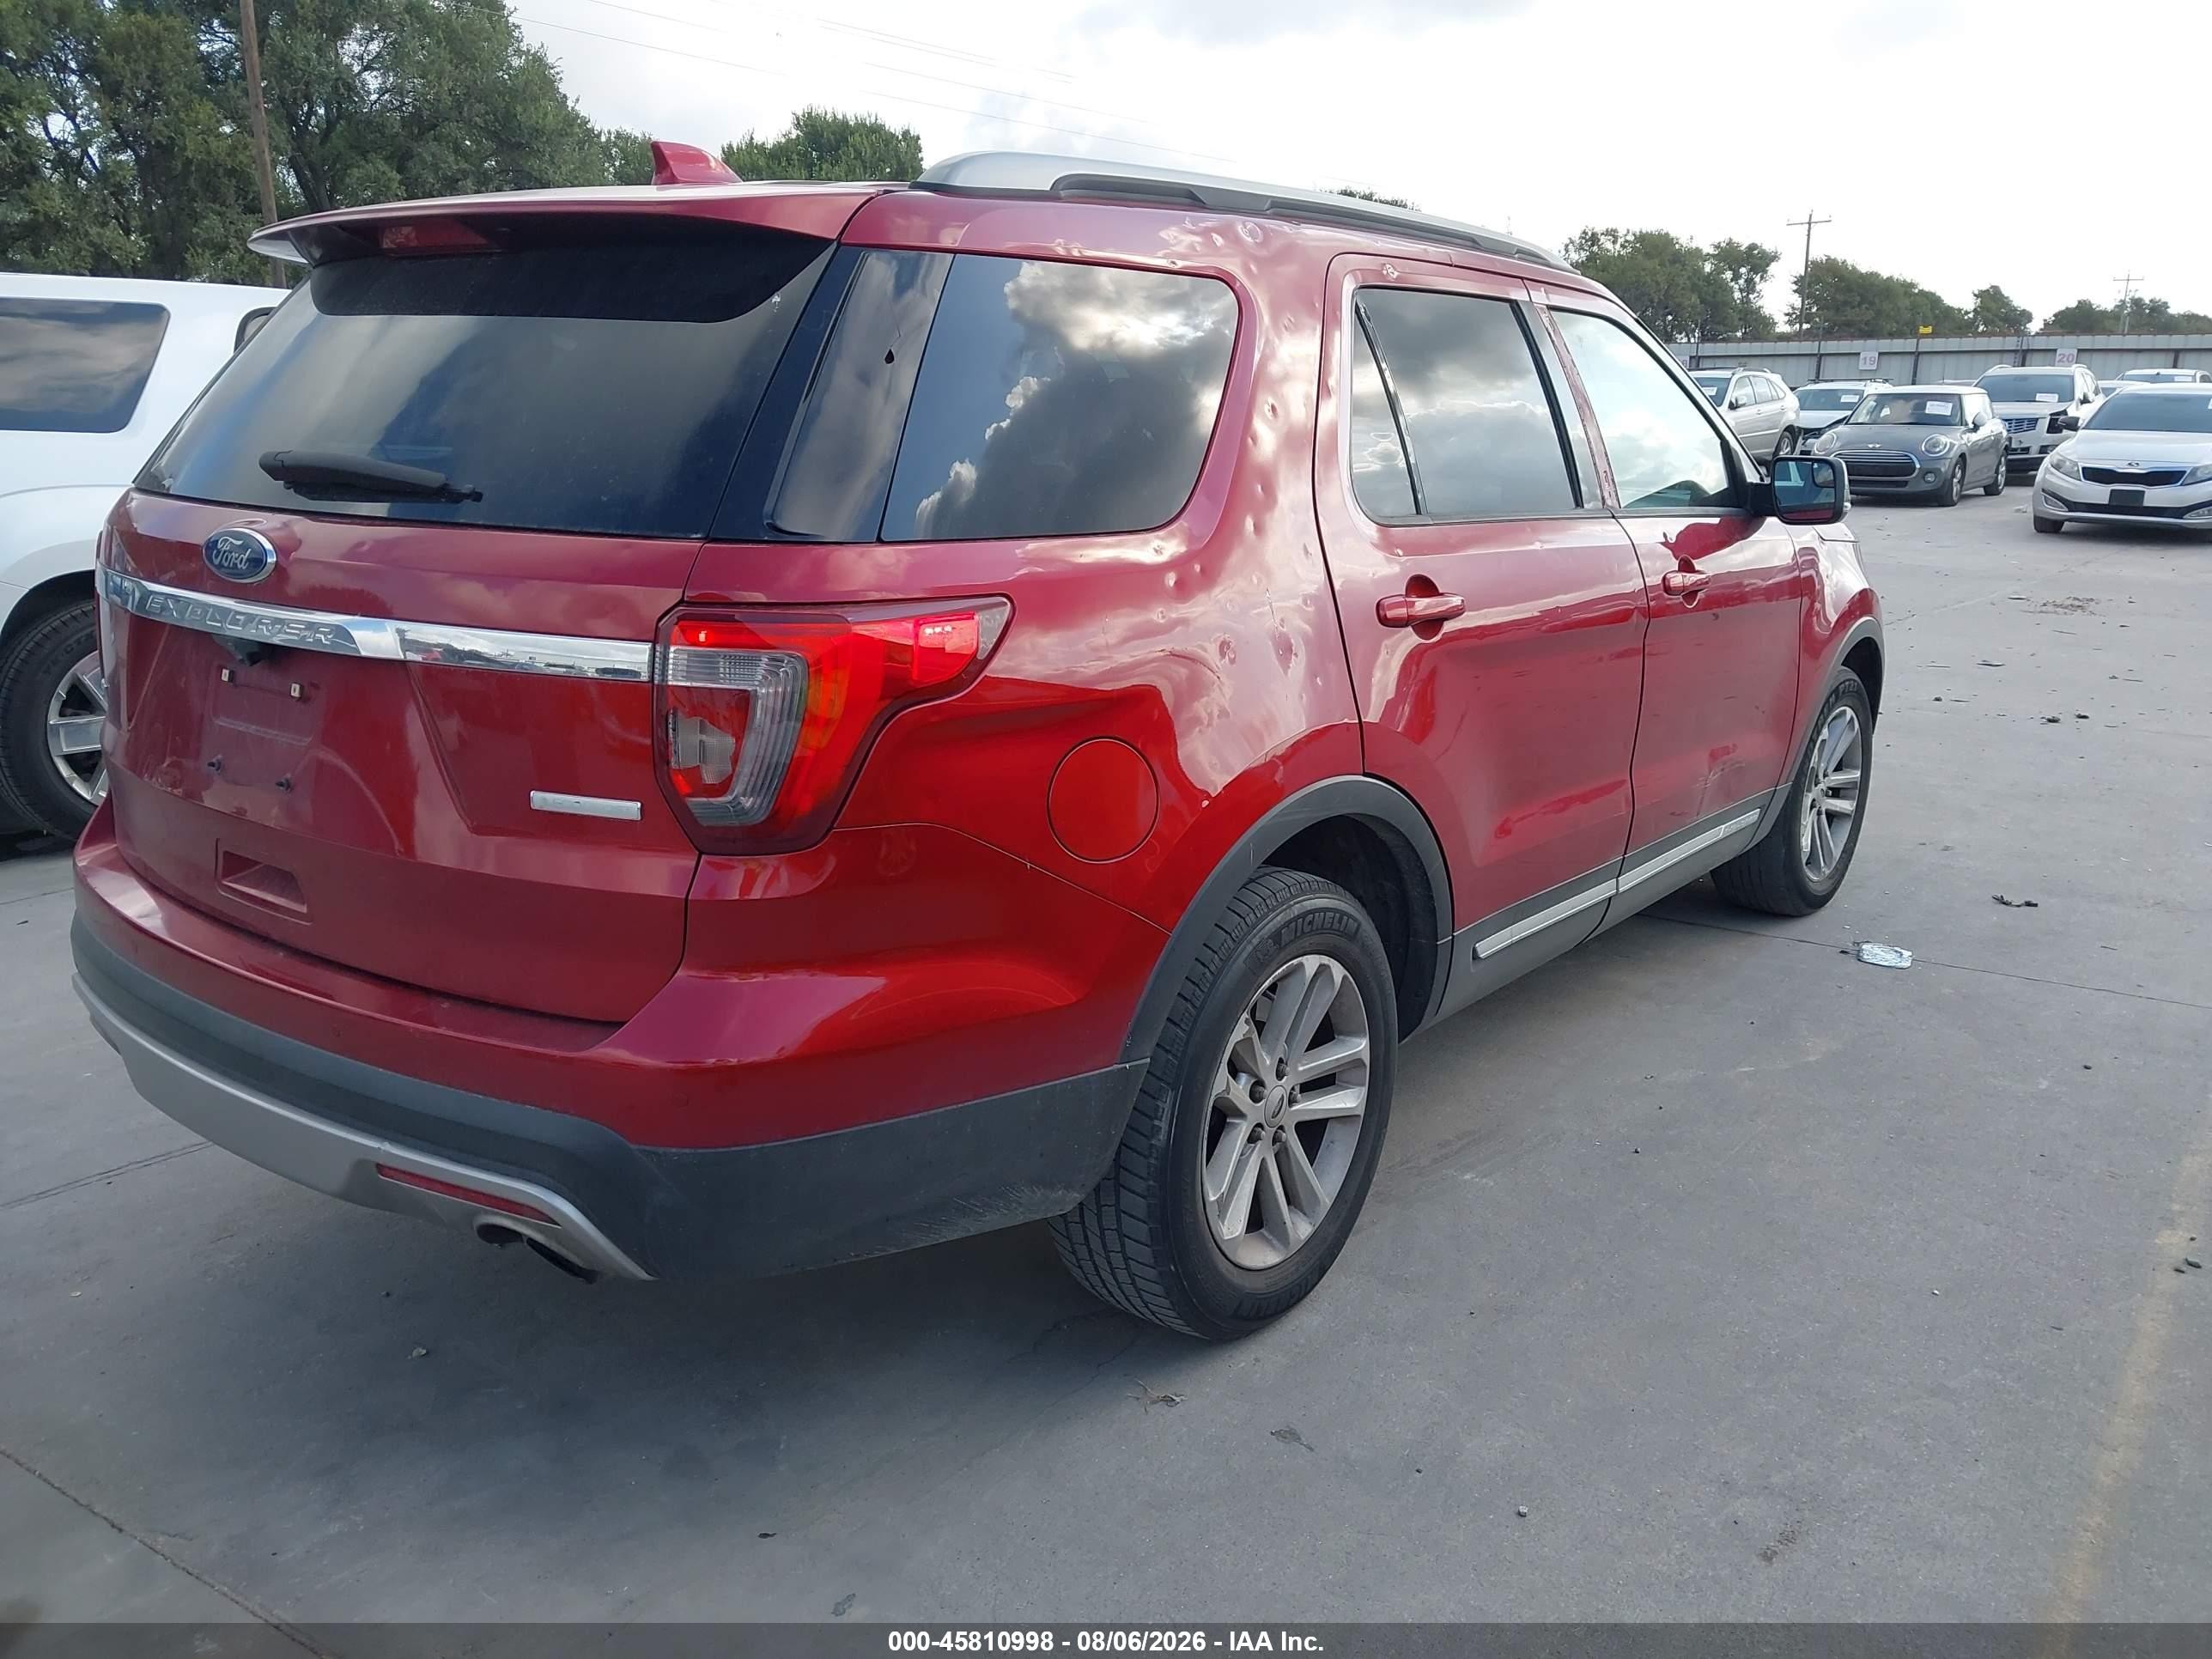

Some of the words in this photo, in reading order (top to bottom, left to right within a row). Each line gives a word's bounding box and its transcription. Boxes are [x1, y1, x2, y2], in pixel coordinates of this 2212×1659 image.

[1861, 356, 1876, 366] 19
[2057, 353, 2075, 364] 20
[212, 536, 252, 570] Ford
[144, 593, 336, 645] EXPLORER
[1280, 911, 1358, 948] MICHELIN
